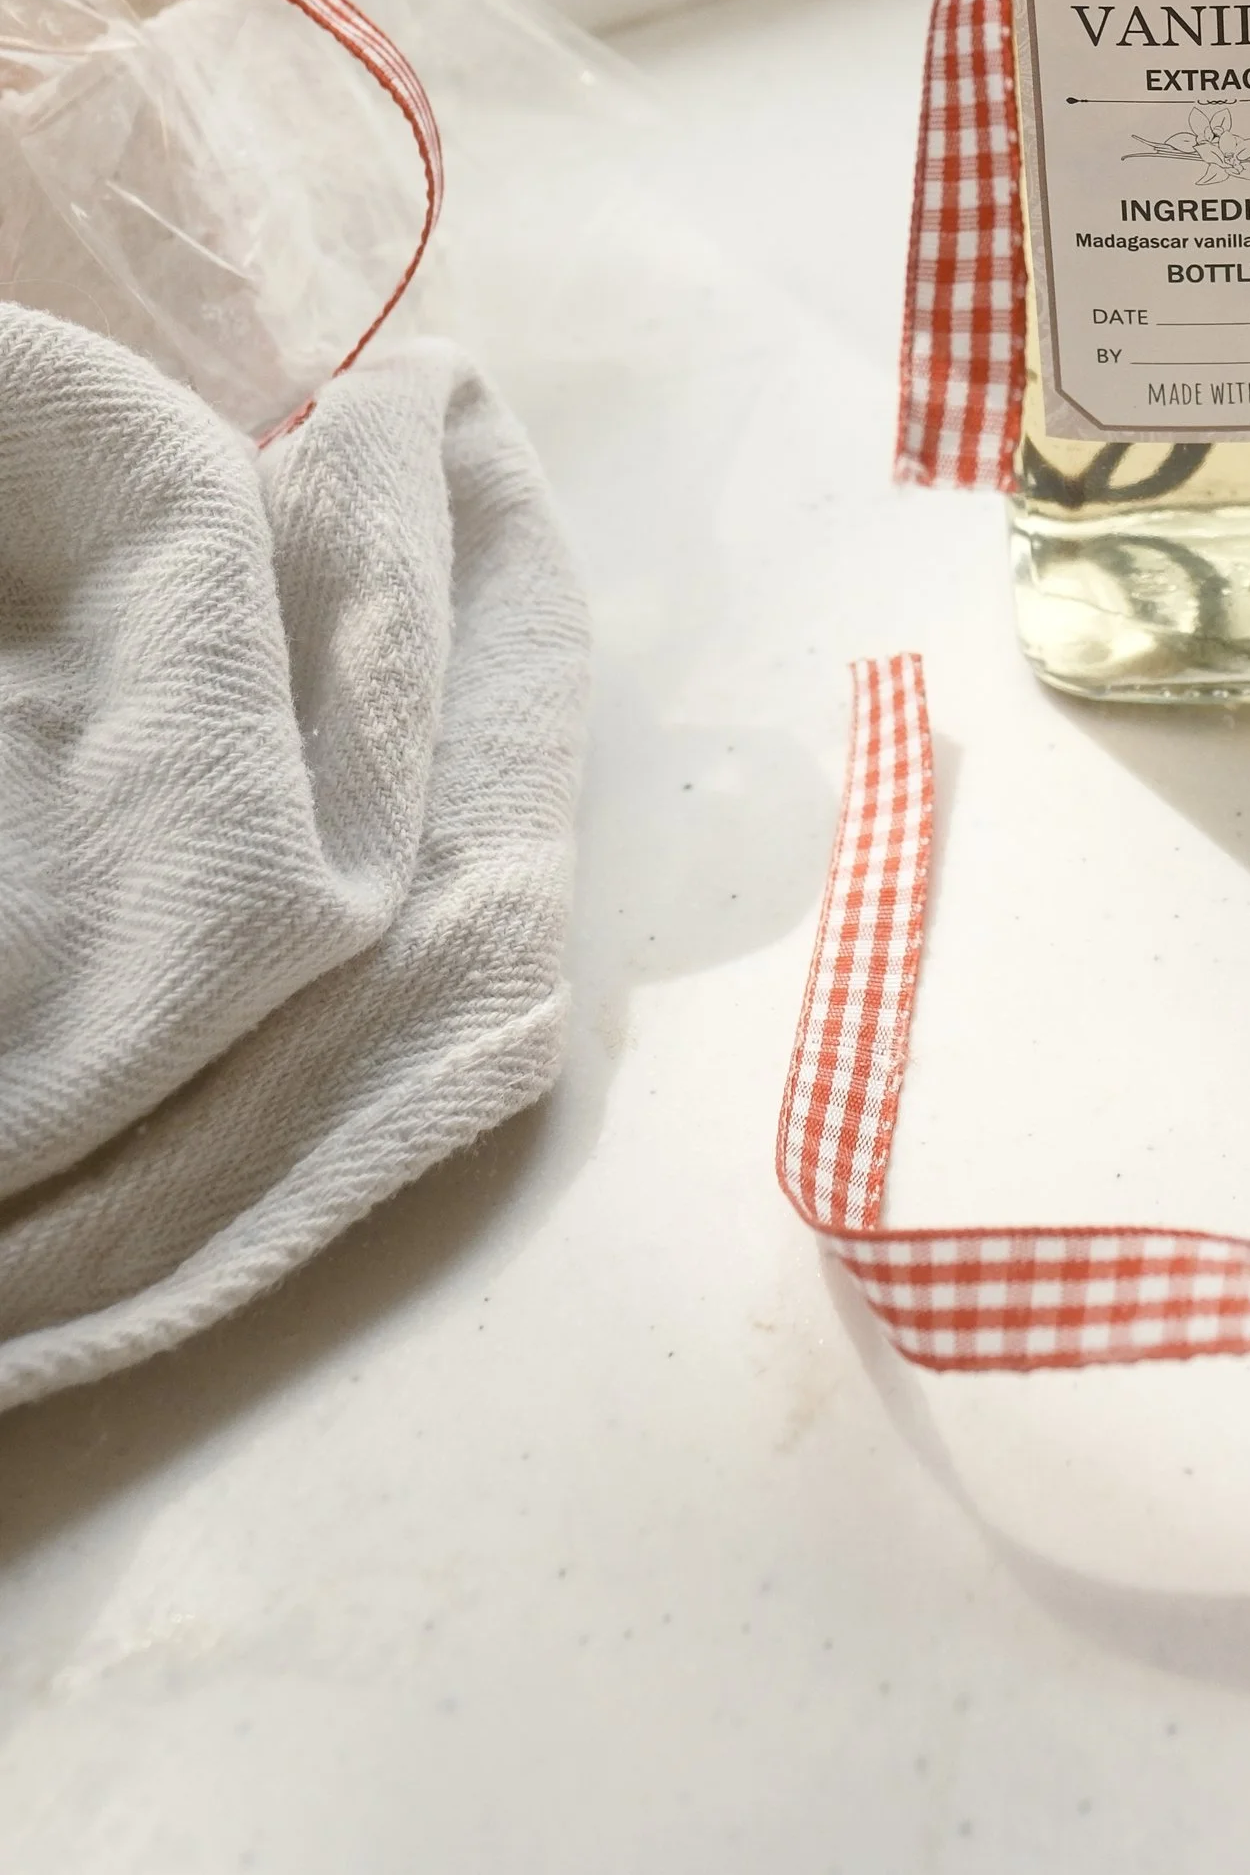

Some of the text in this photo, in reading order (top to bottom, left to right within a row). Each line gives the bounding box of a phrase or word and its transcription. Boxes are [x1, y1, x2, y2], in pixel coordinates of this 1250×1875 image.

[1075, 230, 1190, 252] Madagascar
[1092, 308, 1149, 326] DATE
[1096, 347, 1123, 364] BY
[1148, 383, 1203, 406] MADE
